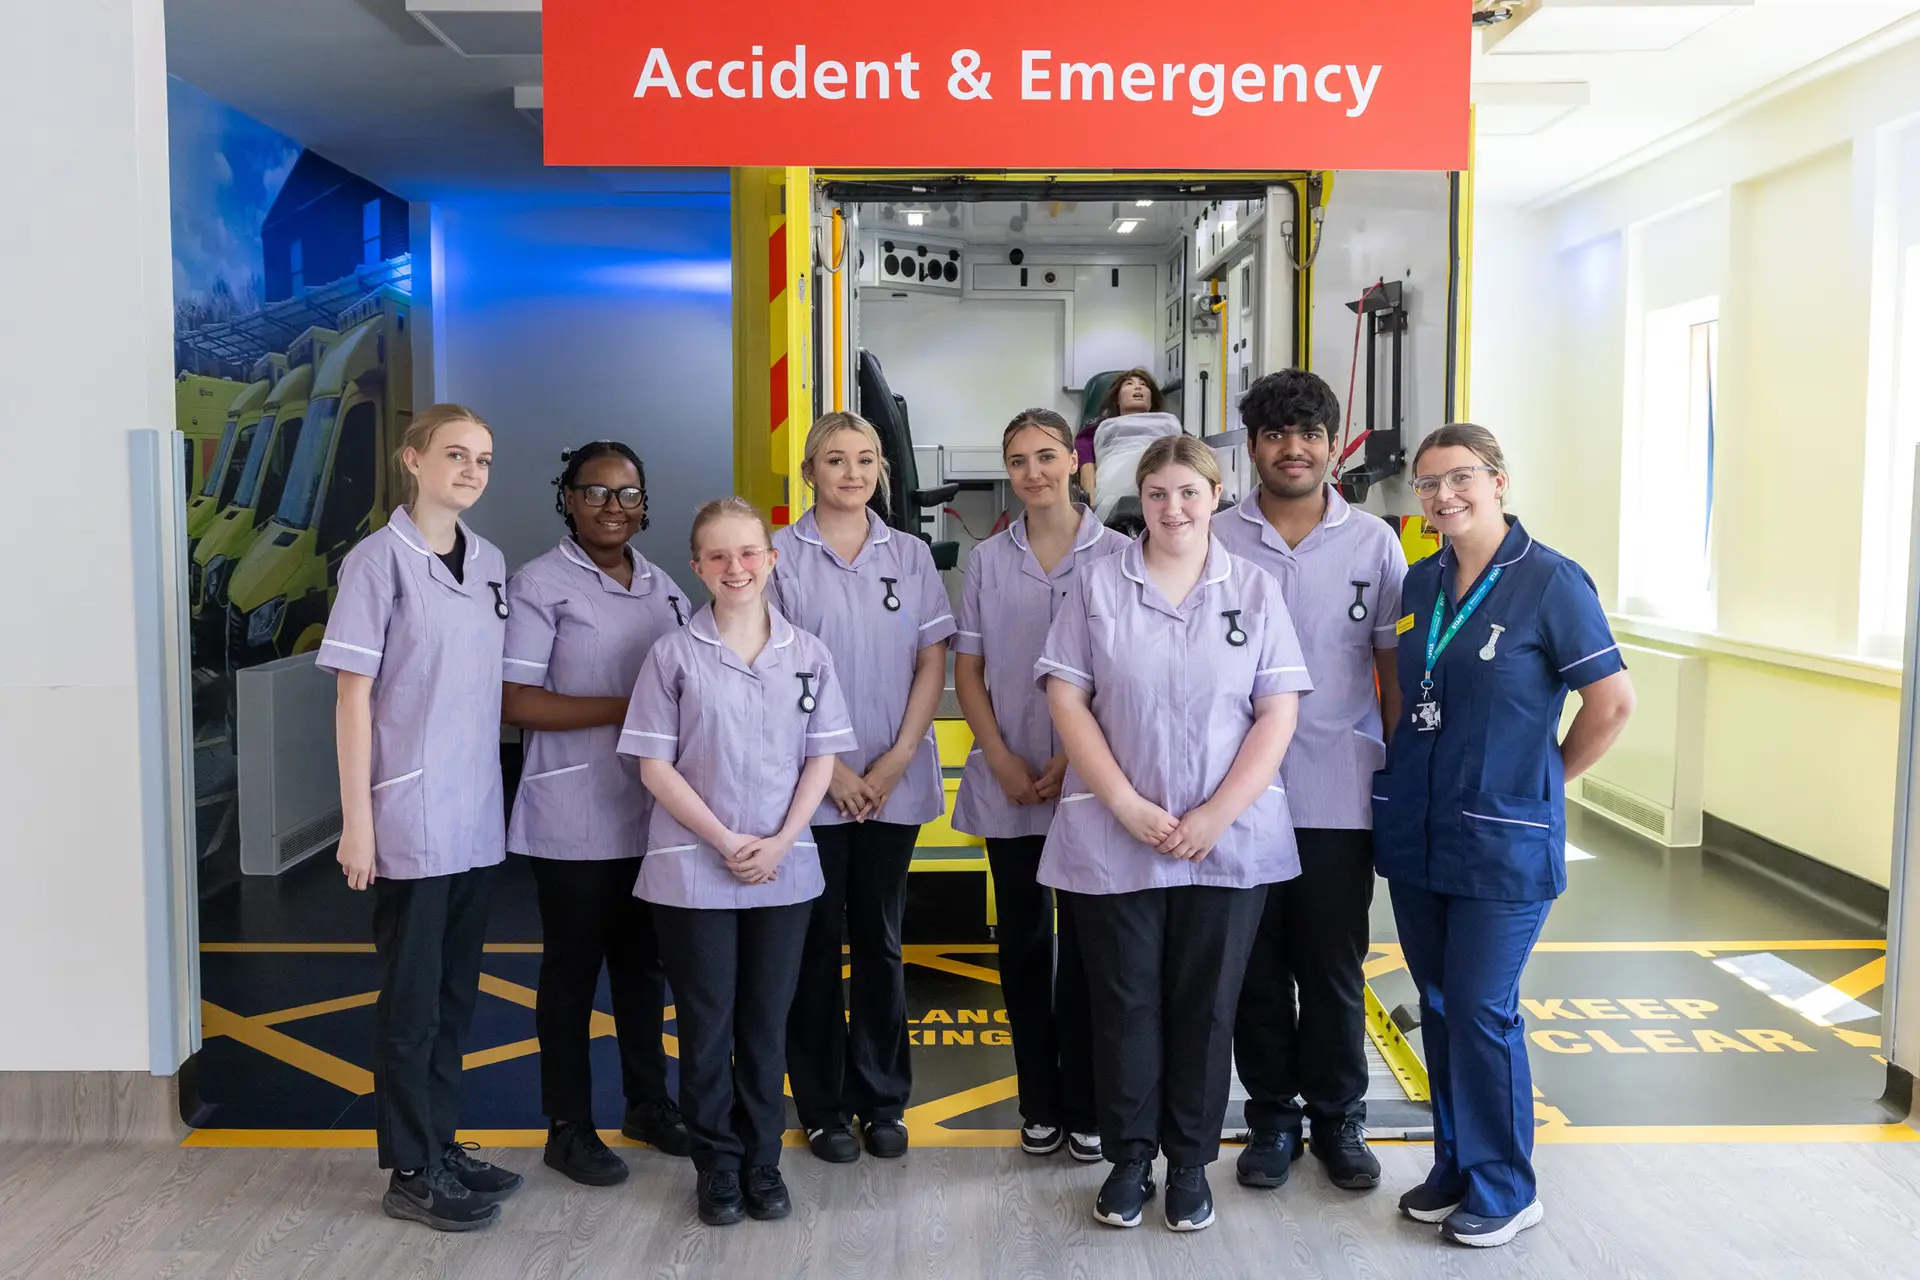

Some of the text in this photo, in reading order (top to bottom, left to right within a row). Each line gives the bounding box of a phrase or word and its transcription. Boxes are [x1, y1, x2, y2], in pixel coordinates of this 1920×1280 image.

[633, 44, 1383, 118] Accident & Emergency
[1451, 613, 1465, 630] STAFF
[1519, 999, 1719, 1020] KEEP
[1530, 1028, 1818, 1054] CLEAR
